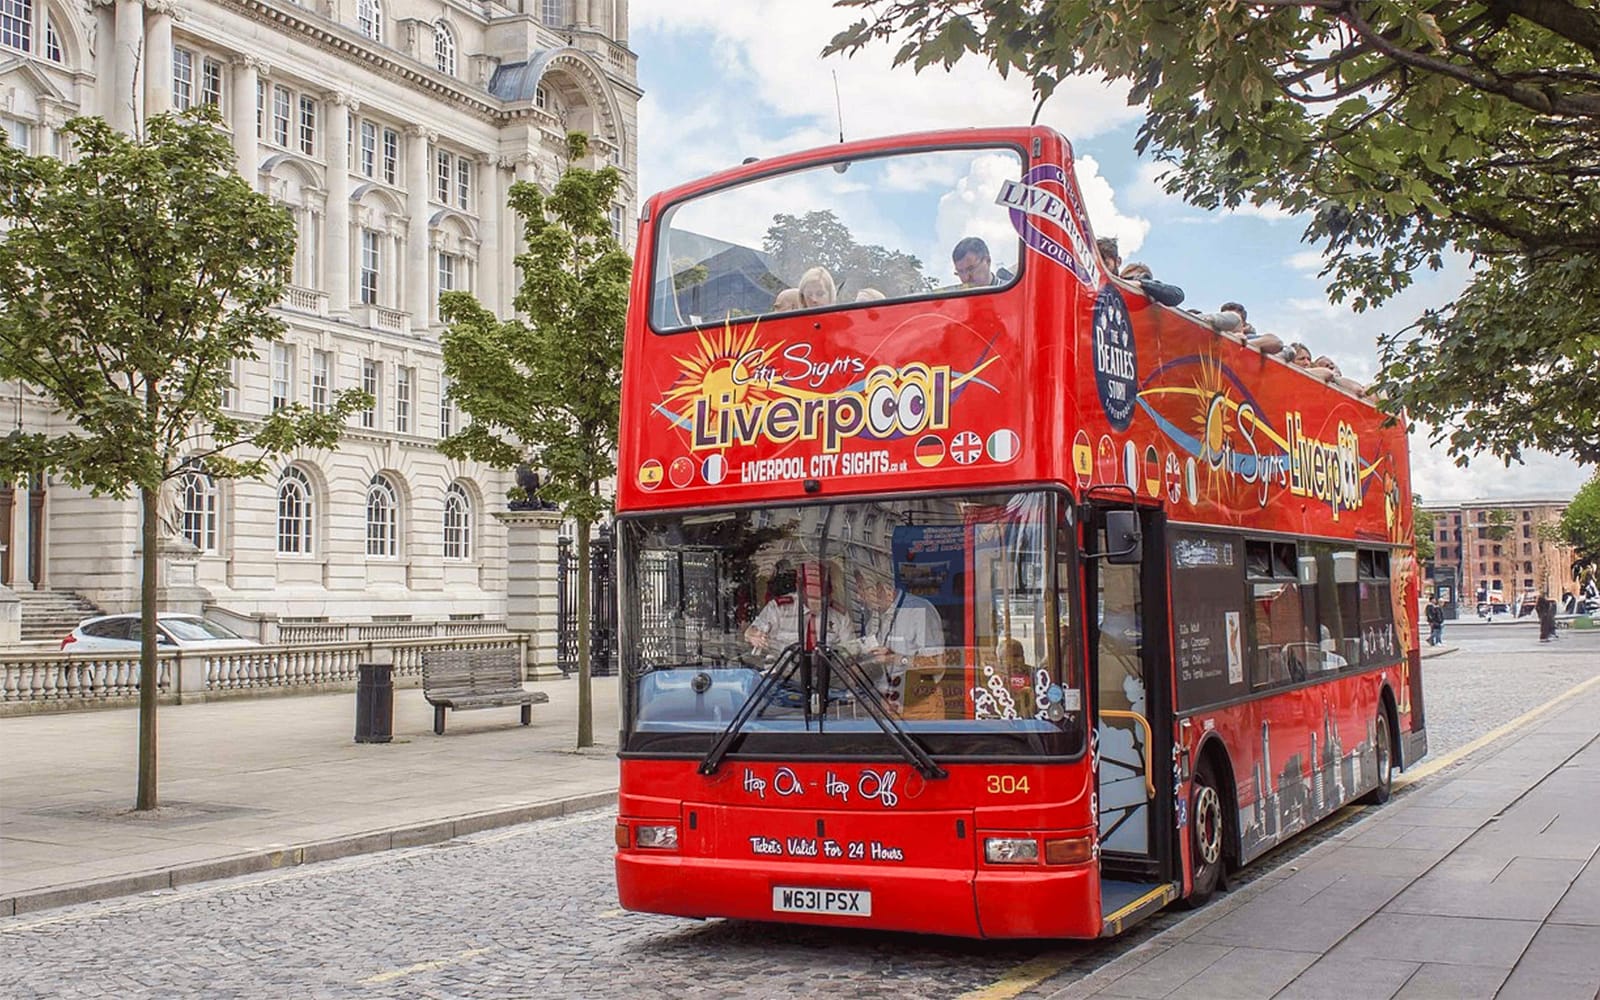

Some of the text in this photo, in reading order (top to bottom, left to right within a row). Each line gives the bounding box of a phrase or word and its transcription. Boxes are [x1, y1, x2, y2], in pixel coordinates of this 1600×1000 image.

[1003, 183, 1097, 277] LIVERPOOL
[1040, 238, 1074, 267] TOUR
[732, 342, 865, 389] City Sights
[1096, 326, 1134, 380] BEATLES
[692, 361, 951, 453] Liverpool
[741, 457, 807, 483] LIVERPOOL
[810, 454, 838, 477] CITY
[1286, 411, 1363, 522] Liverpool
[743, 767, 767, 798] Hop
[774, 766, 804, 796] On
[825, 770, 850, 802] Hop
[858, 769, 899, 807] Off
[987, 775, 1030, 794] 304
[750, 836, 904, 861] Tickets Valid For 24 Hours
[783, 890, 860, 911] W631 PSX
